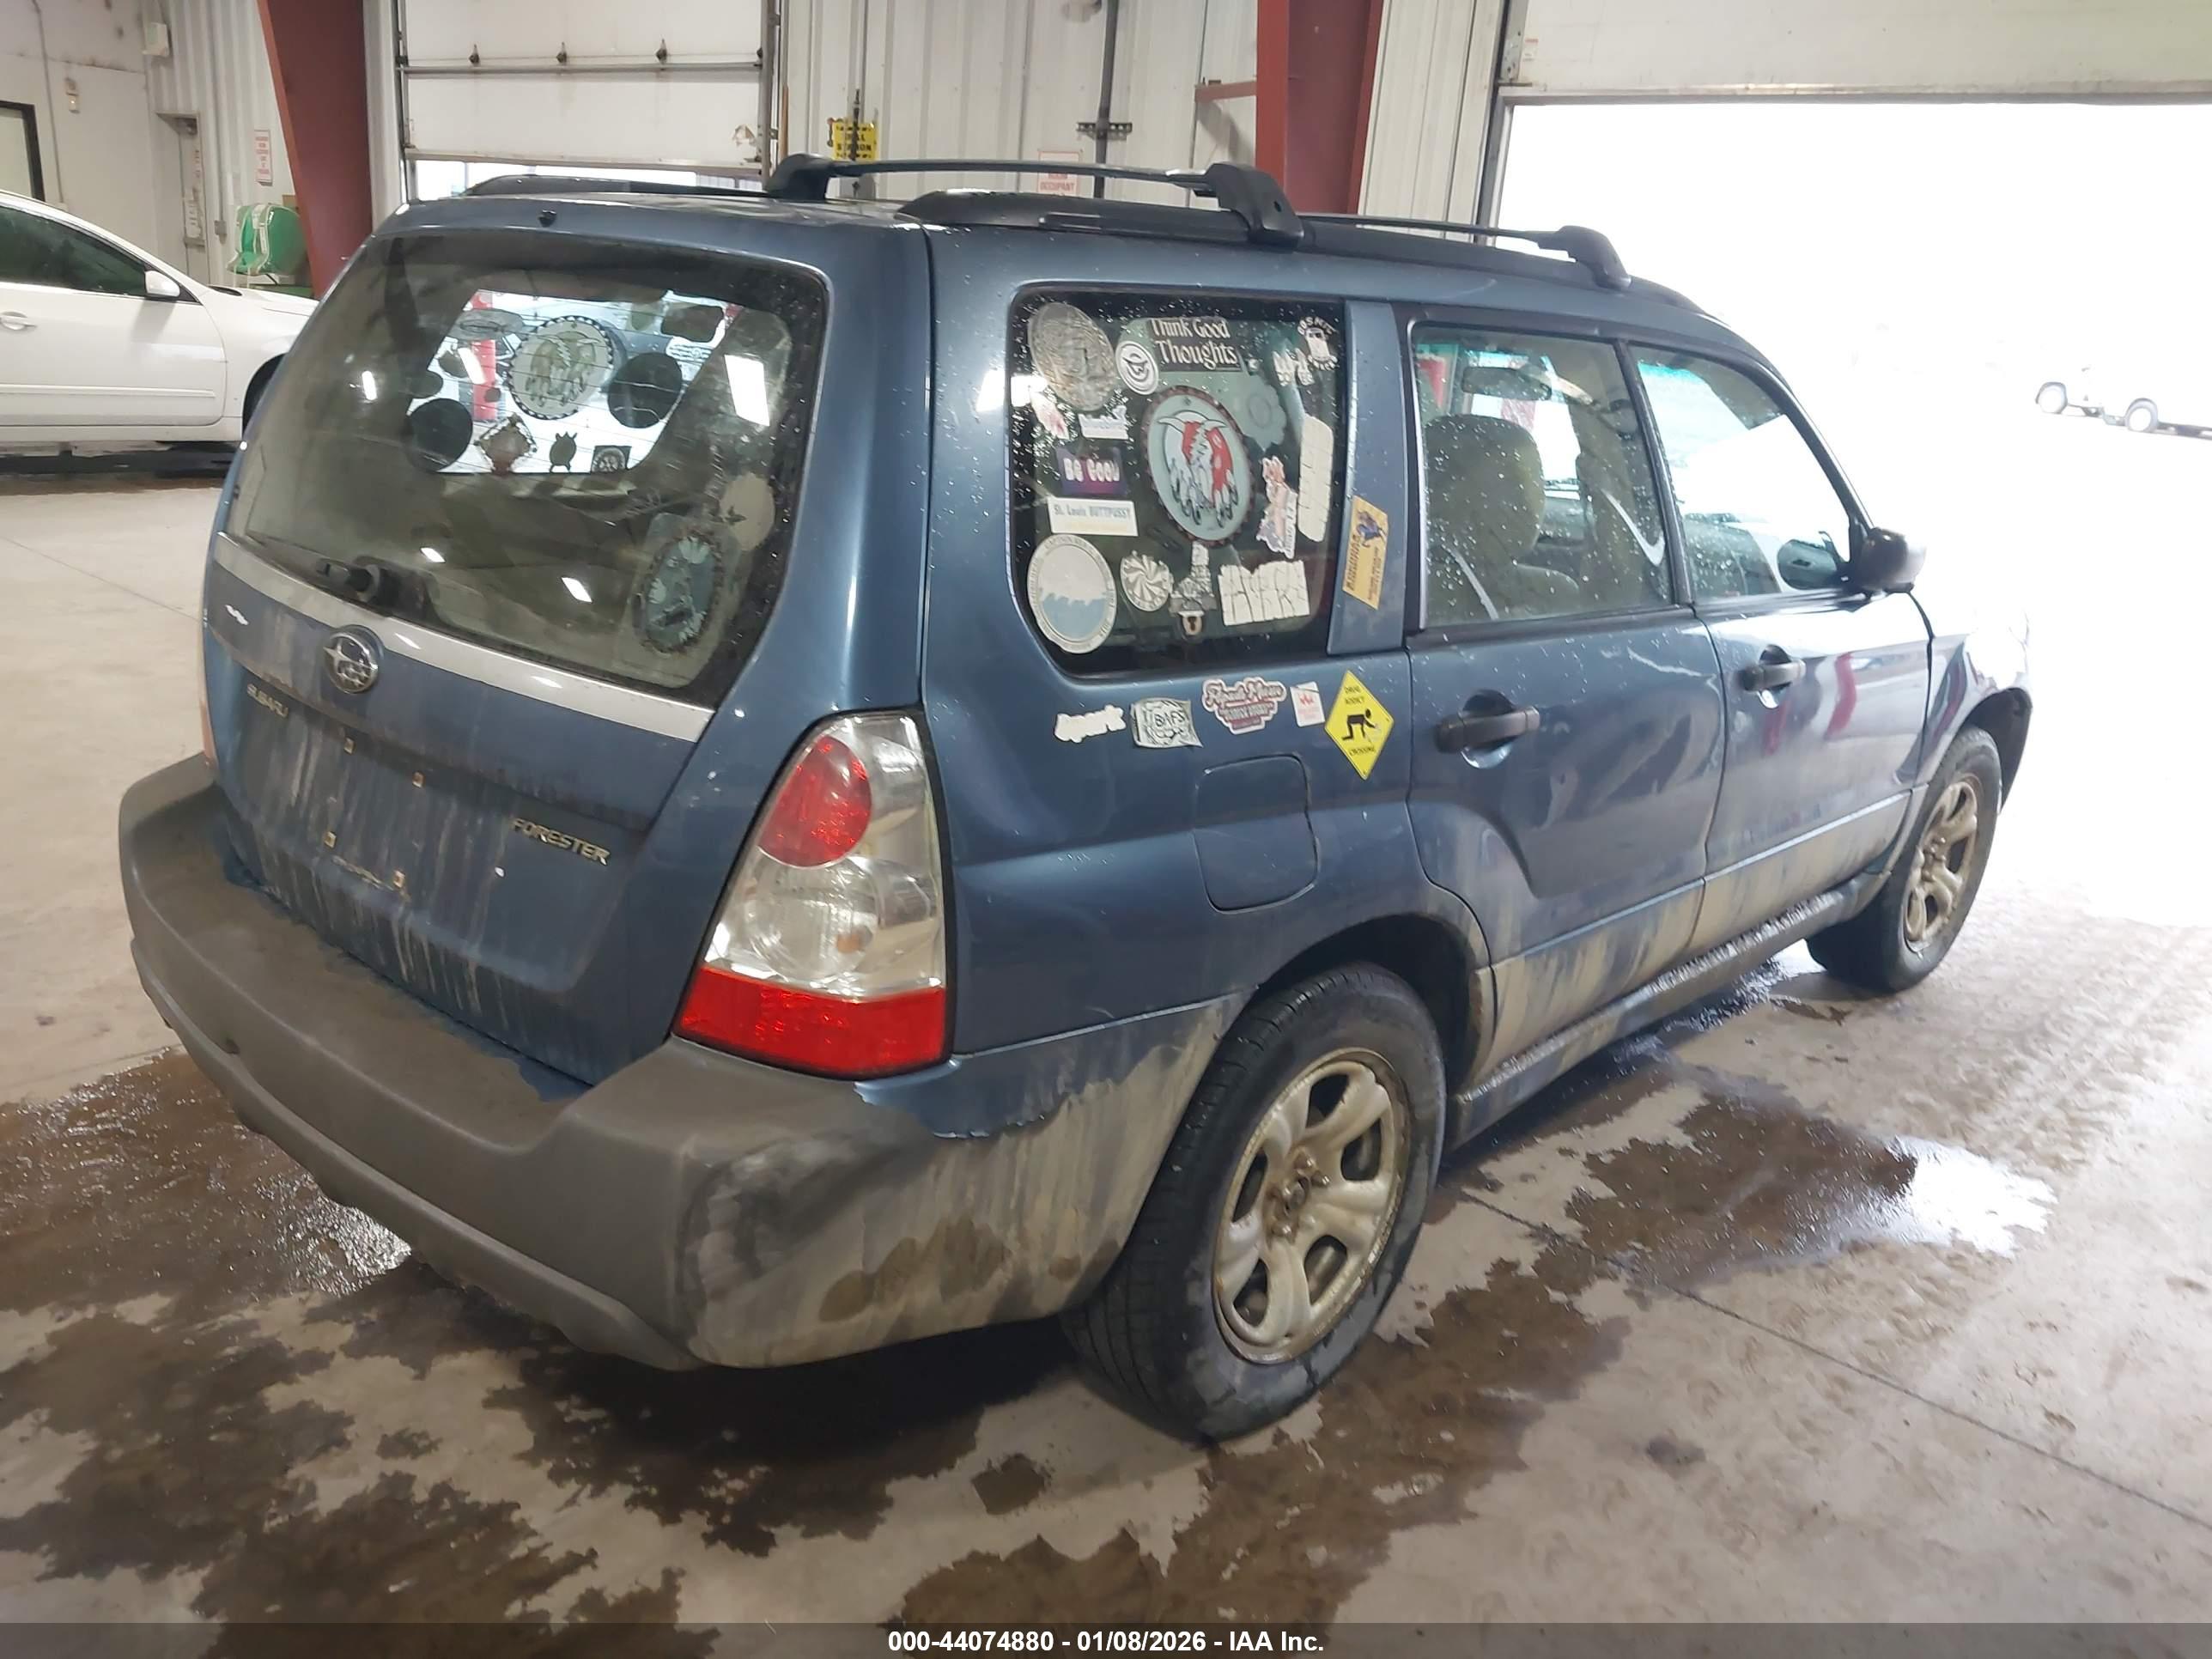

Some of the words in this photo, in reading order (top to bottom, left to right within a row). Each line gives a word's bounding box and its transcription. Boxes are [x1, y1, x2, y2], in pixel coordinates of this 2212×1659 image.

[1151, 318, 1194, 337] Think
[1192, 318, 1231, 338] Good
[1154, 338, 1237, 370] Thoughts
[246, 684, 289, 718] SUBARU
[513, 817, 611, 866] FORESTER
